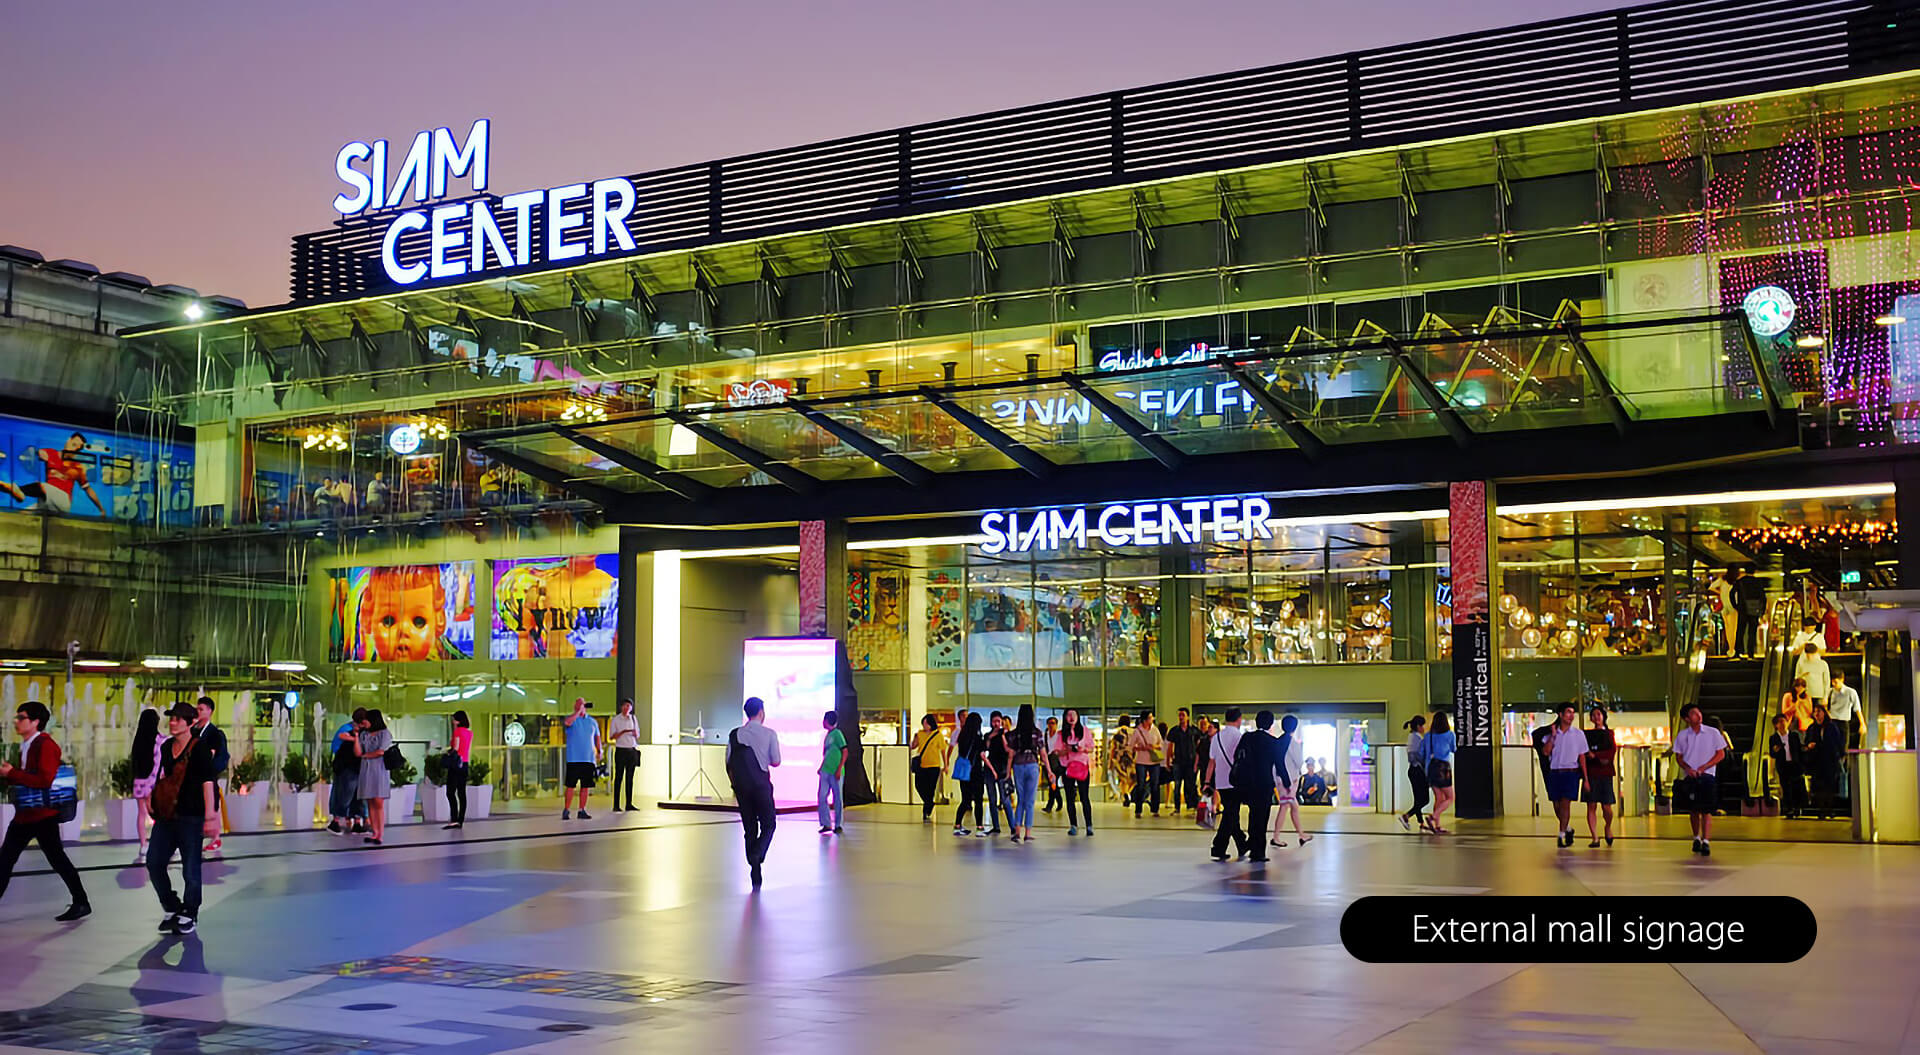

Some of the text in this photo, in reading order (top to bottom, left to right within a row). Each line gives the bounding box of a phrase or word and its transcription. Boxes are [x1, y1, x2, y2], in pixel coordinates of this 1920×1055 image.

[333, 118, 491, 215] SIAM
[381, 176, 638, 285] CENTER
[980, 497, 1273, 554] SIAM CENTER
[1473, 657, 1489, 747] INvertical
